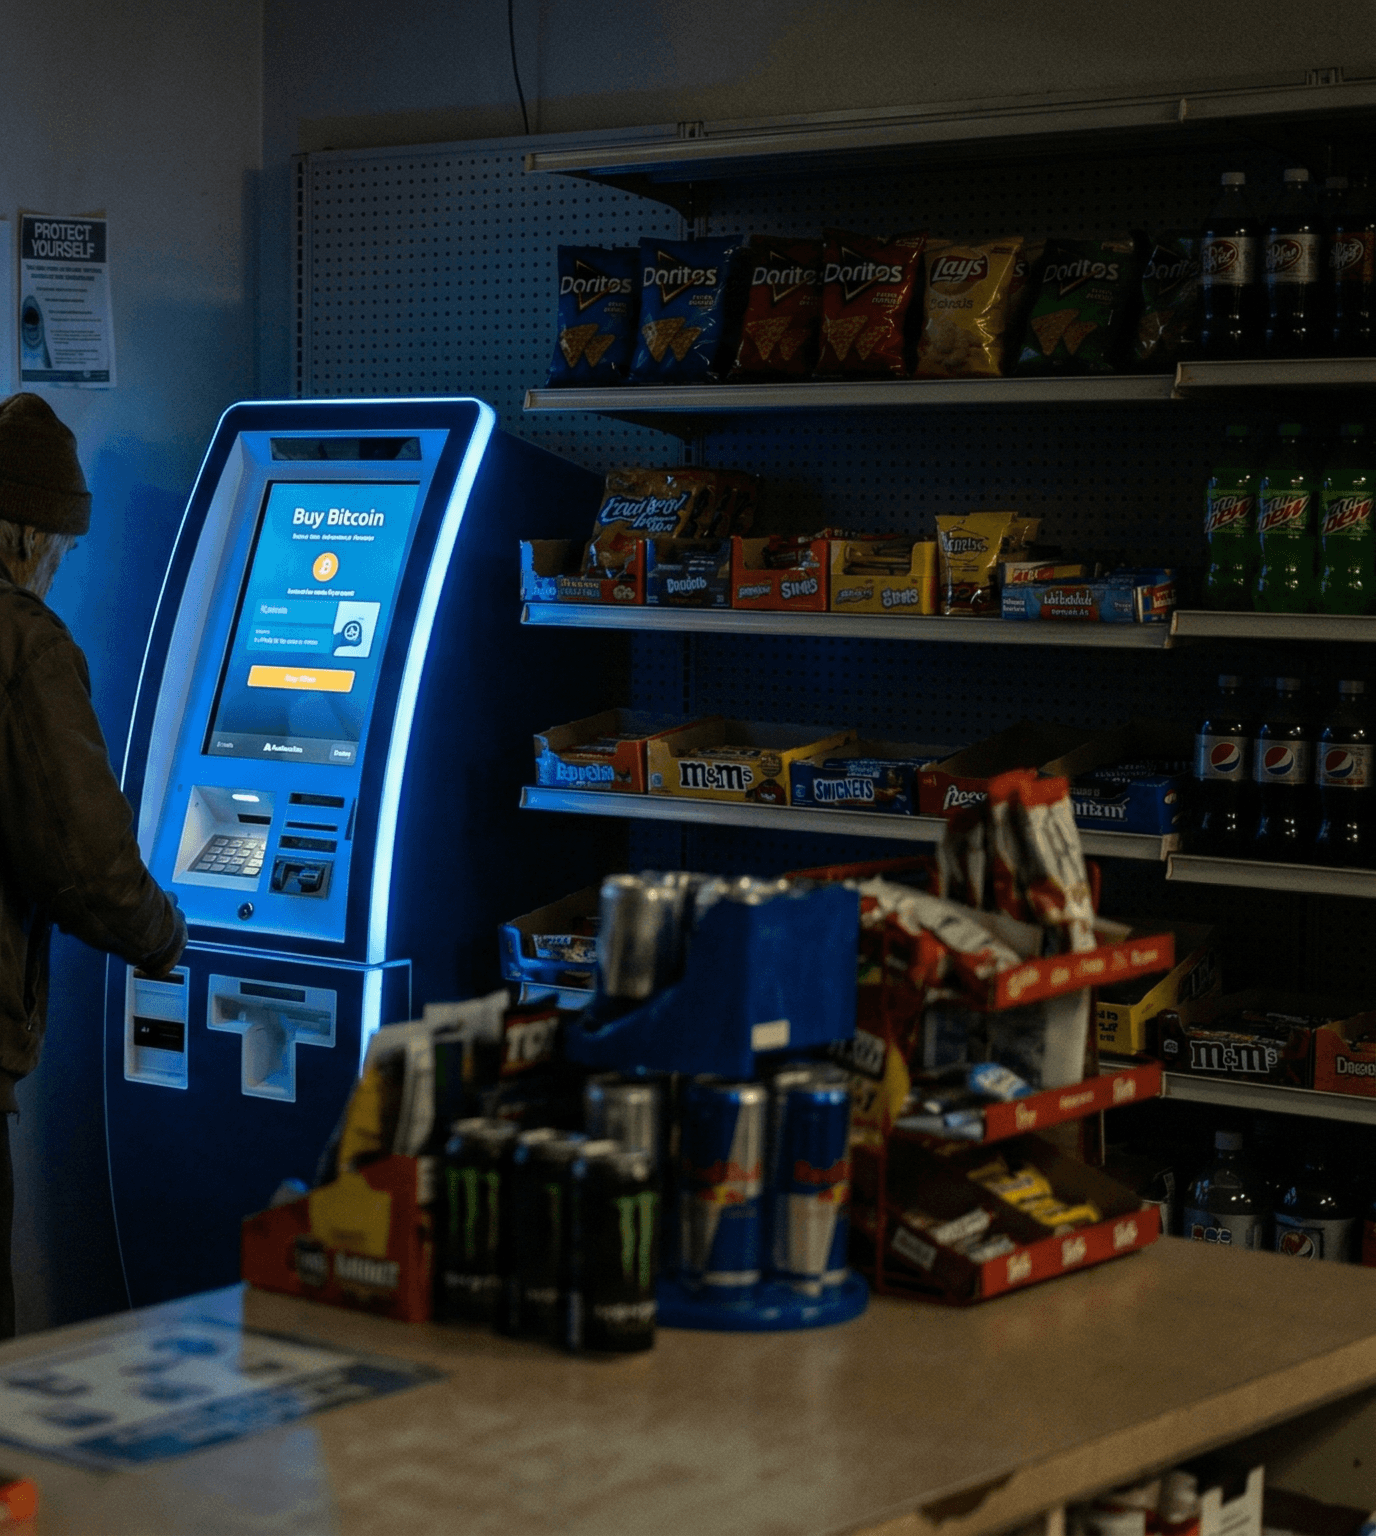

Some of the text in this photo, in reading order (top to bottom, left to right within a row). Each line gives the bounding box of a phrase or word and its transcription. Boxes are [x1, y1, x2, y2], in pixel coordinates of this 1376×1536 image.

[34, 222, 92, 241] PROTECT
[31, 239, 95, 259] YOURSELF
[643, 265, 718, 288] Doritos
[824, 262, 903, 283] Doritos
[1043, 259, 1120, 283] Doritos
[560, 275, 633, 296] Doritos
[292, 507, 385, 530] Buy Bitcoin
